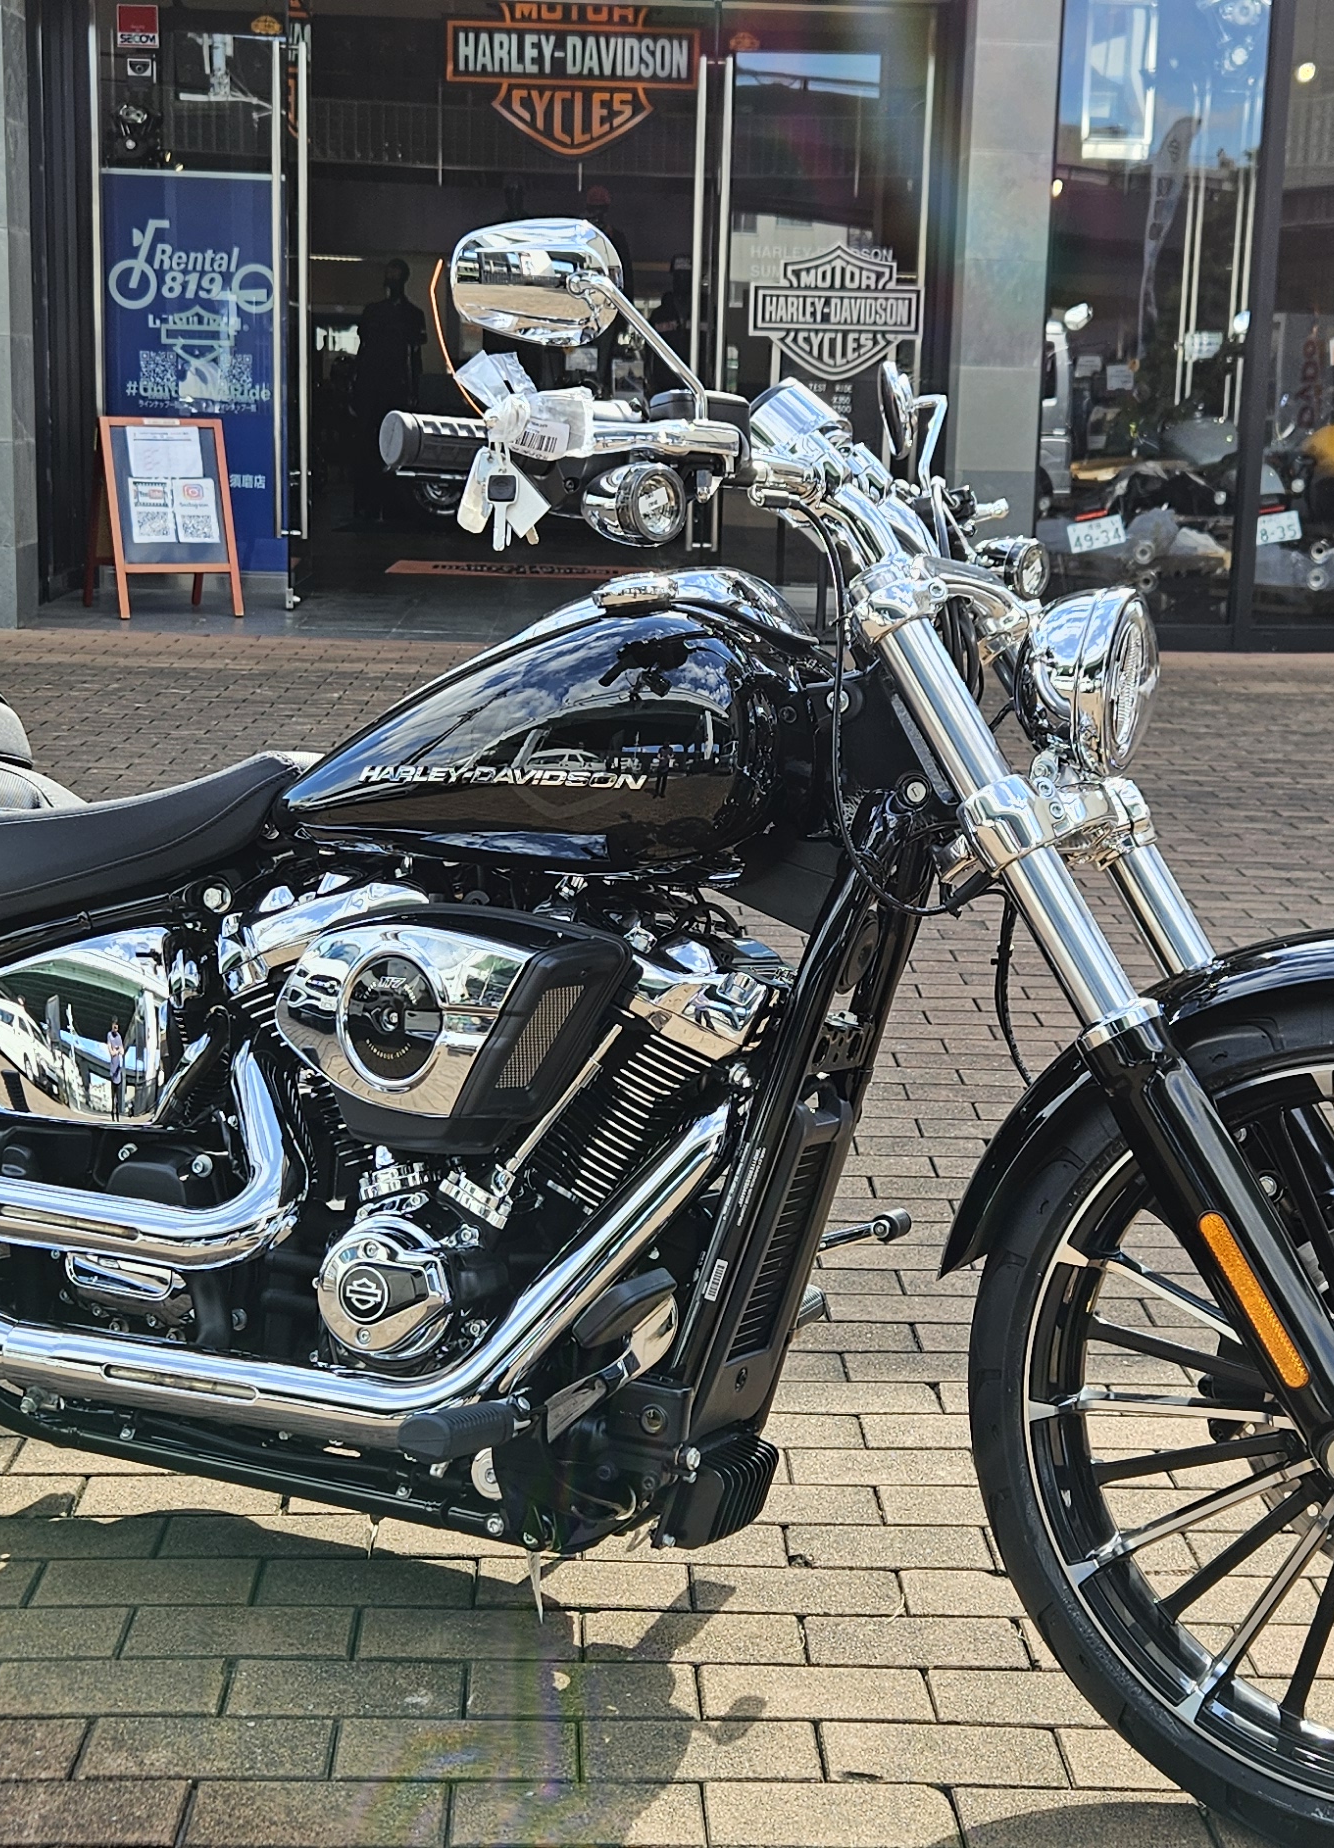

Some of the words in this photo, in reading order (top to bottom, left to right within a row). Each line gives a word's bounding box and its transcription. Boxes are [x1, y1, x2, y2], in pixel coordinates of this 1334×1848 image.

[119, 33, 156, 44] SECOM
[458, 31, 688, 79] HARLEY-DAVIDSON
[511, 88, 633, 145] CYCLES
[153, 243, 240, 273] Rental
[161, 272, 223, 299] 819
[800, 258, 877, 290] MOTOR
[765, 296, 909, 326] HARLEY-DAVIDSON
[796, 331, 874, 367] CYCLES
[809, 383, 827, 392] TEST
[835, 384, 853, 393] RIDE
[229, 474, 266, 489] 須磨店
[1074, 527, 1121, 551] 49-34
[358, 765, 647, 790] HARLEY-DAVIDSON
